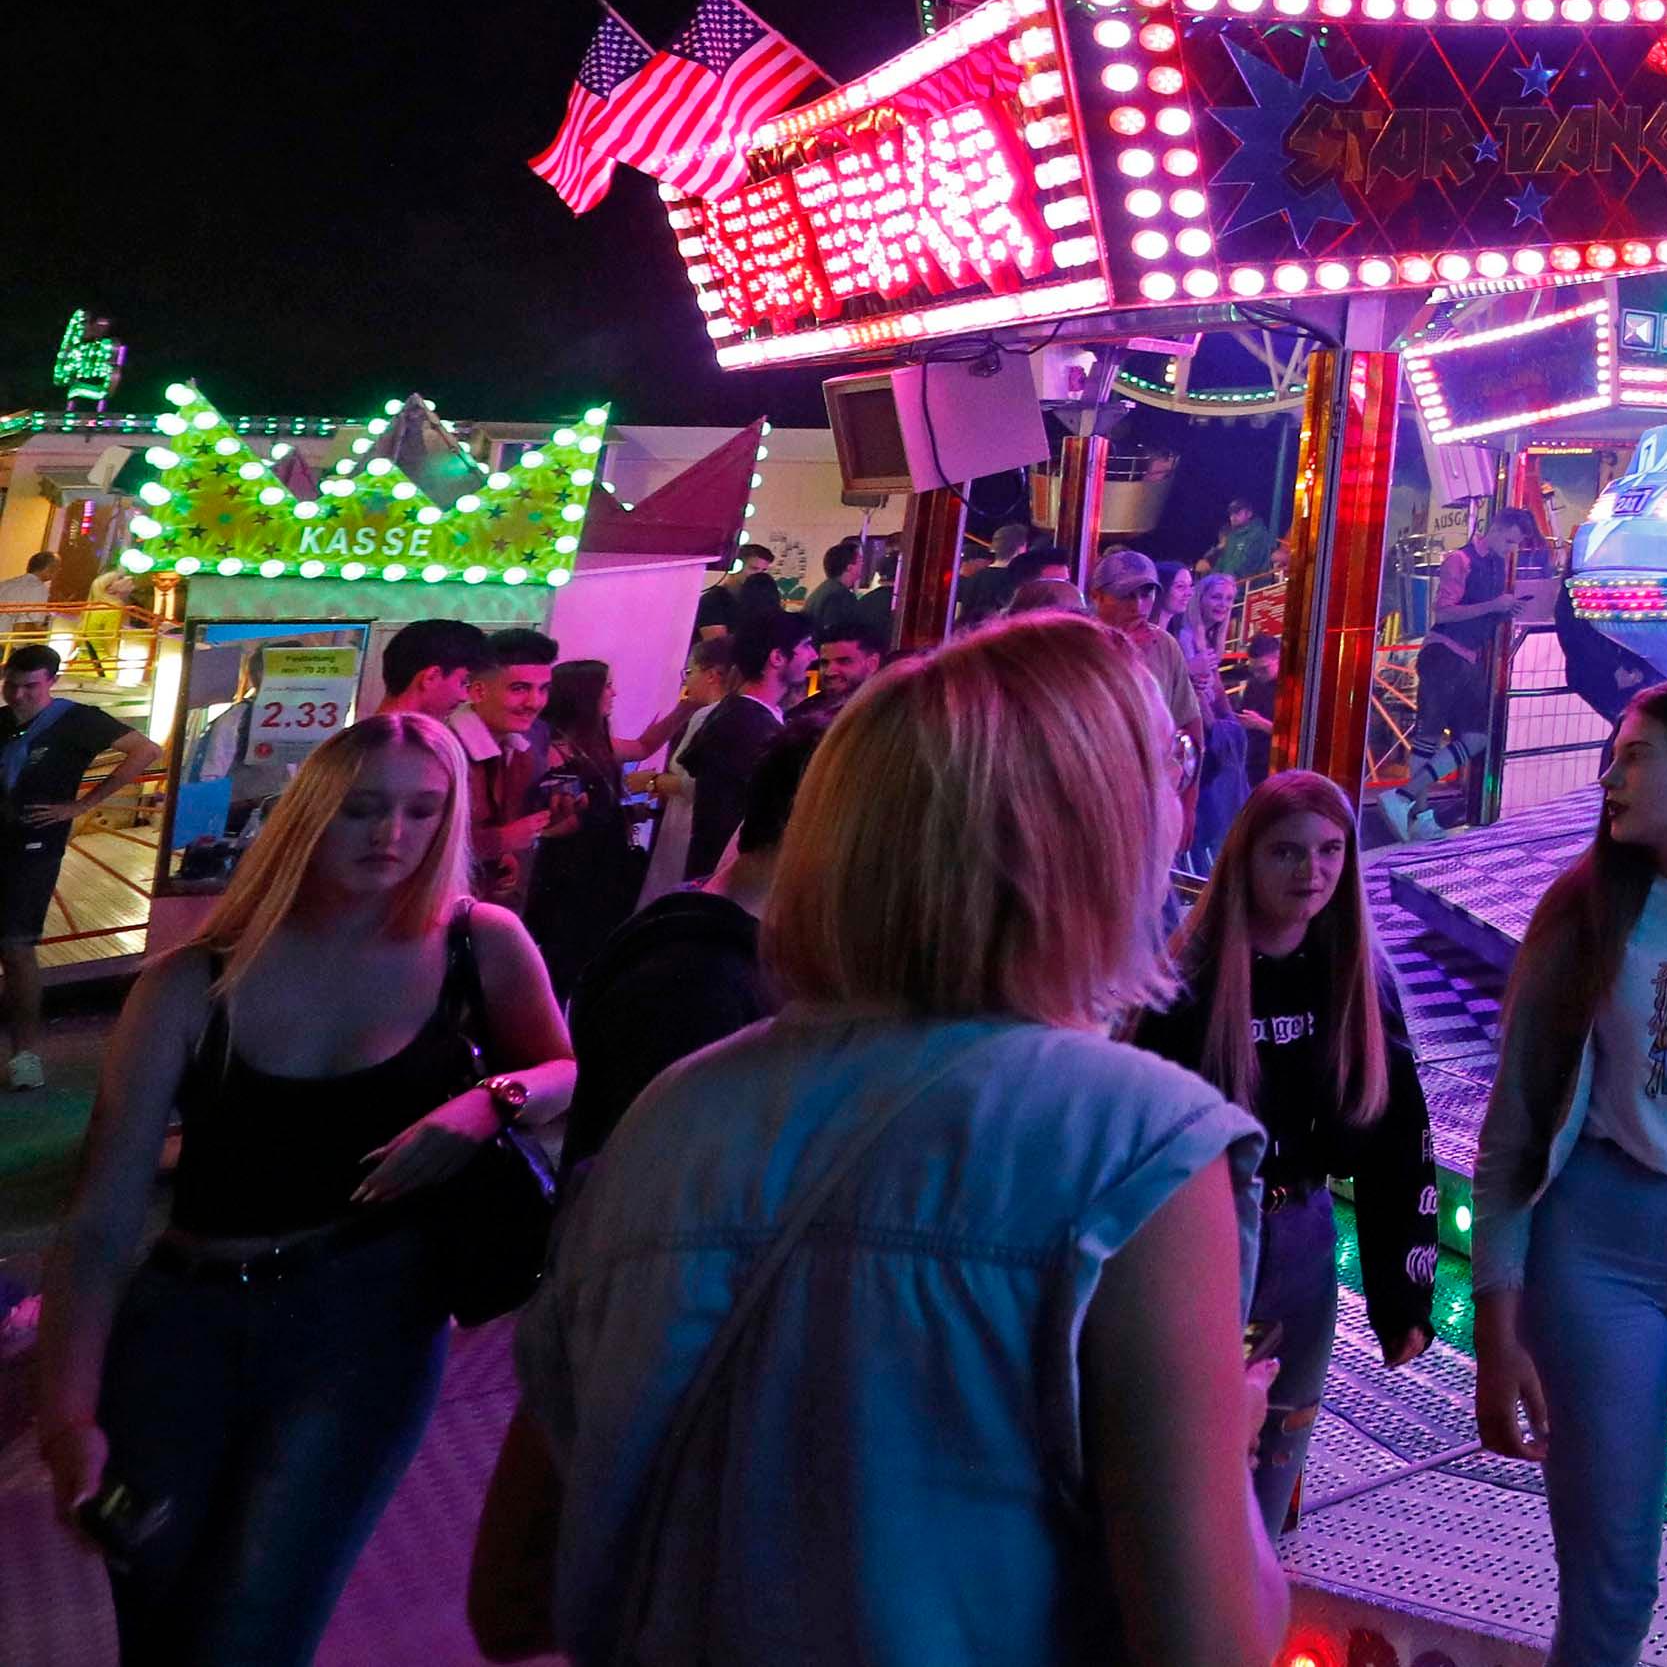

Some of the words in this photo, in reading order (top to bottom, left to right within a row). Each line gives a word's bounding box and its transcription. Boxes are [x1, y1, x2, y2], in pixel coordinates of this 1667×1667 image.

[1283, 104, 1477, 196] STAR
[1433, 510, 1485, 533] AUSGAG
[298, 525, 434, 557] KASSE
[260, 700, 339, 729] 2.33
